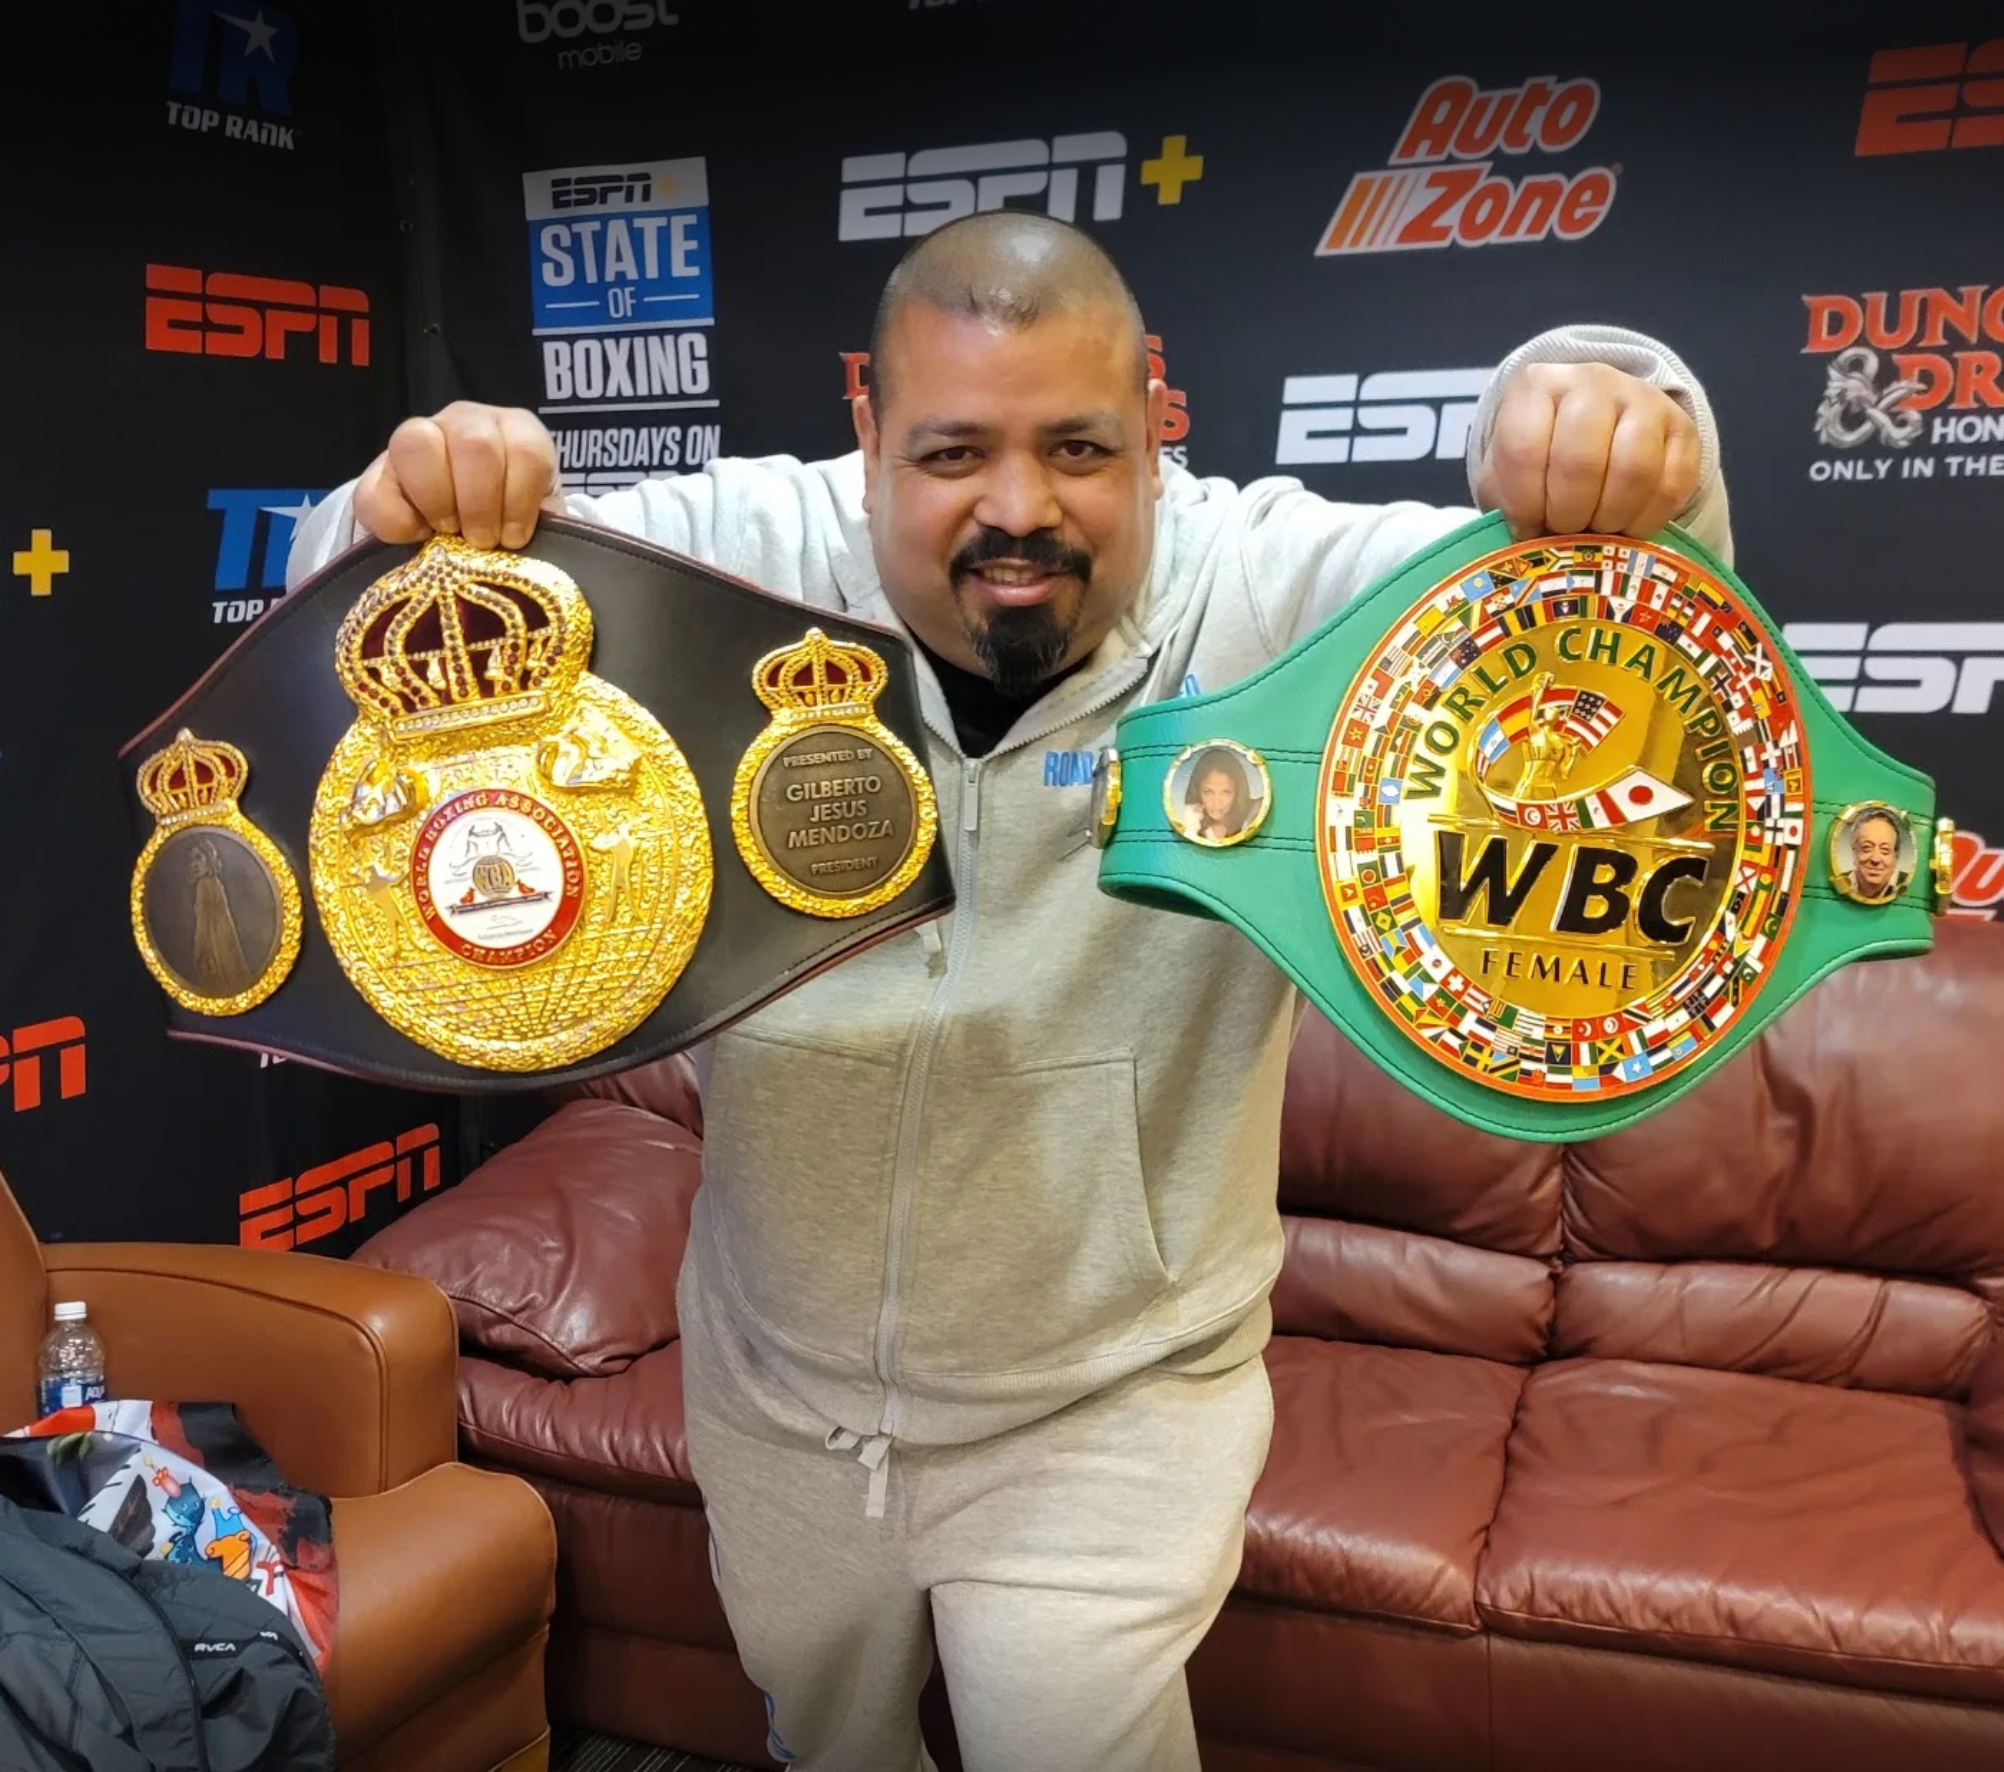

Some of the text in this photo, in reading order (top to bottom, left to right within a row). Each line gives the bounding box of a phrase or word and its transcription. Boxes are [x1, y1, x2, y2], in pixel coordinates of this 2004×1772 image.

[558, 40, 643, 70] mobile
[166, 101, 295, 151] TOP RANK
[1390, 76, 1599, 164] Auto
[1395, 164, 1615, 248] Zone
[540, 214, 700, 287] STATE
[146, 263, 370, 367] ESPN
[607, 287, 636, 319] OF
[543, 333, 710, 400] BOXING
[685, 424, 721, 466] ON
[1809, 455, 2004, 481] ONLY IN THE
[212, 600, 264, 624] TOP
[1404, 627, 1739, 831] WORLD CHAMPION
[782, 748, 872, 768] PRESENTED BY
[786, 775, 881, 801] GILBERTO
[809, 800, 867, 823] JESUS
[788, 820, 894, 848] MENDOZA
[415, 793, 581, 922] WORLD BOXING ASSOCIATION
[810, 857, 878, 875] PRESIDENT
[1436, 830, 1709, 946] WBC
[1482, 948, 1637, 991] FEMALE
[239, 1123, 440, 1252] ESPN
